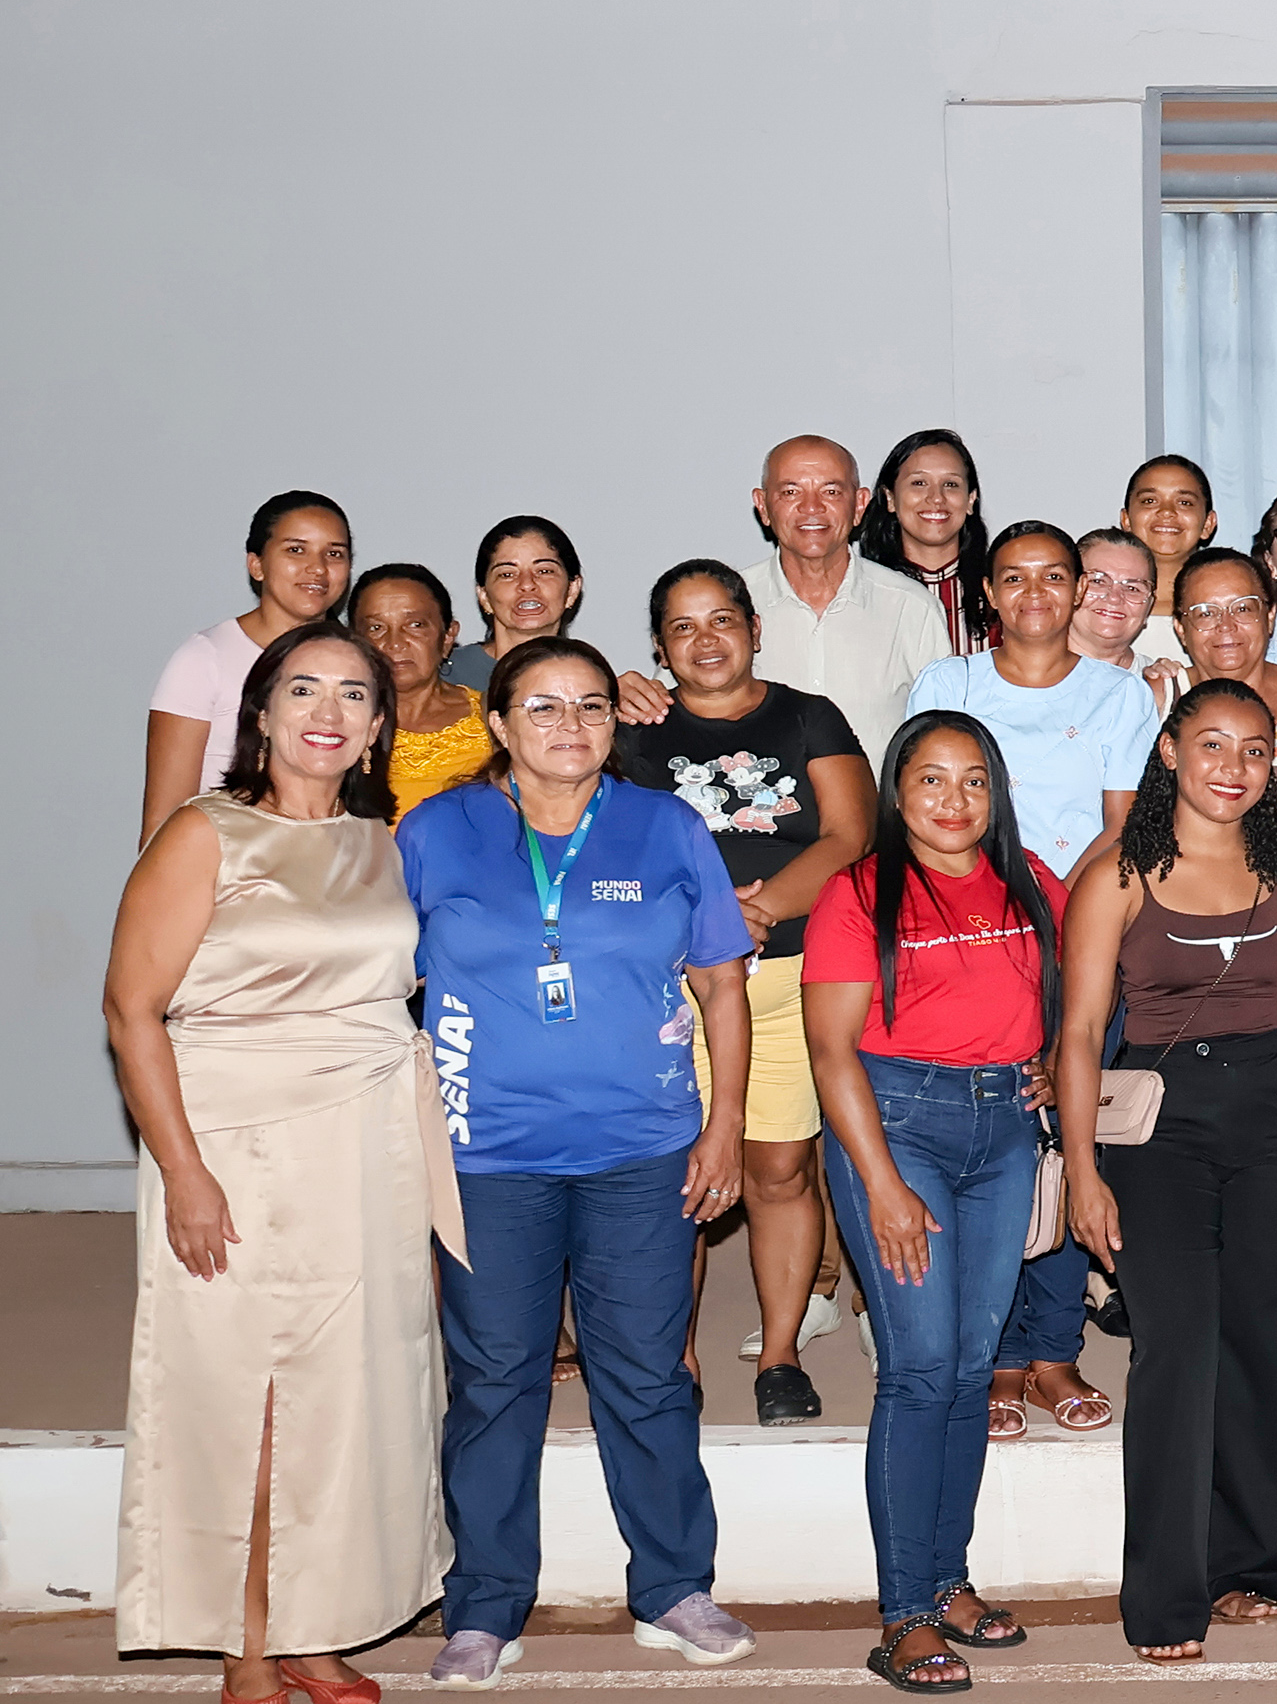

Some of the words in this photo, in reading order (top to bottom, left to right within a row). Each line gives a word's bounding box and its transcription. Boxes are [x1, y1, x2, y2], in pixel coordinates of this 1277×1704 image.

[591, 880, 642, 890] MUNDO
[591, 890, 643, 902] SENAI
[968, 938, 991, 947] TIAGO
[434, 993, 474, 1145] SENAI
